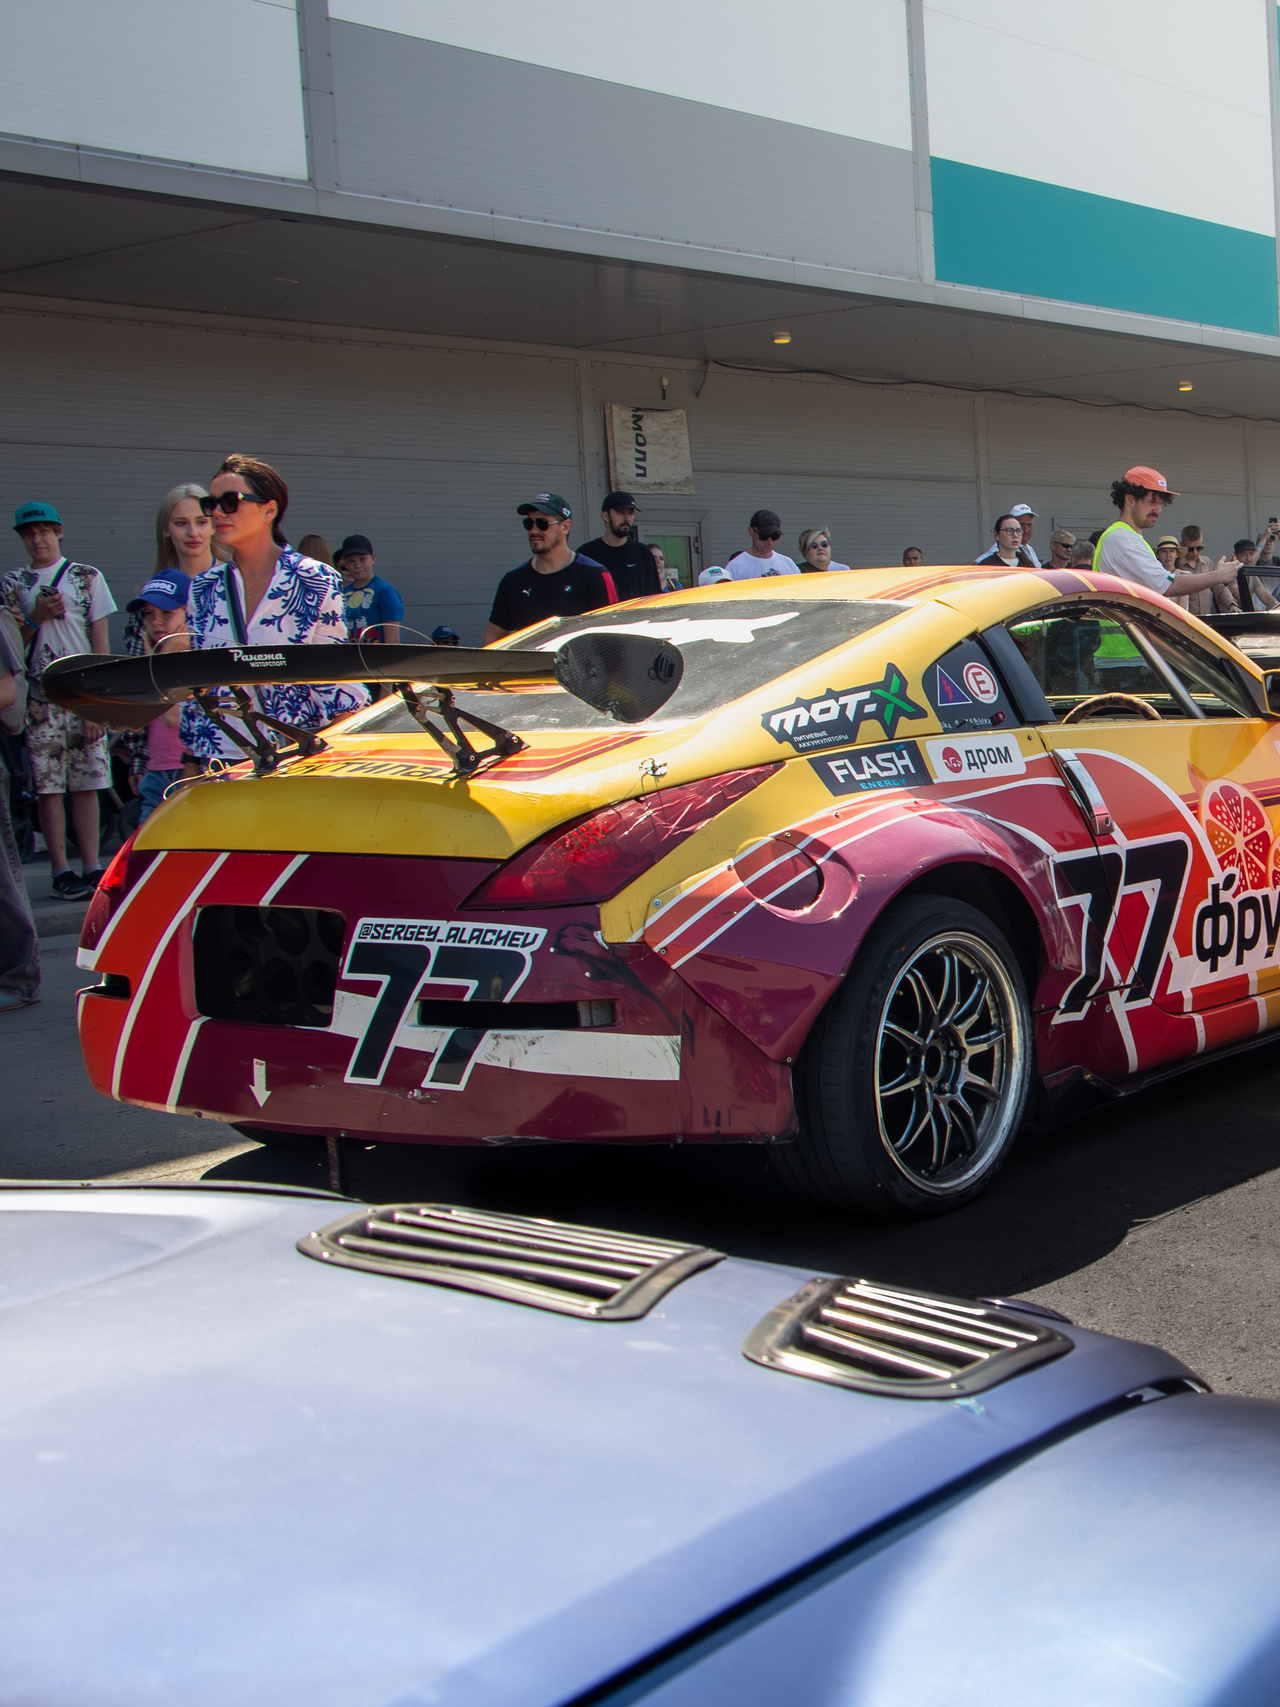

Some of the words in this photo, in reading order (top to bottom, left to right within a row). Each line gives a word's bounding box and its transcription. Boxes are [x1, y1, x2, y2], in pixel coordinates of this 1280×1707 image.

[798, 734, 849, 749] АККУМУЛЯТОРЫ
[827, 750, 916, 784] FLASH
[964, 746, 1013, 773] дром
[859, 778, 907, 790] ENERGY
[358, 922, 540, 949] @SERGEY_ALACHEV
[1054, 837, 1189, 1015] 77
[346, 941, 527, 1086] 77
